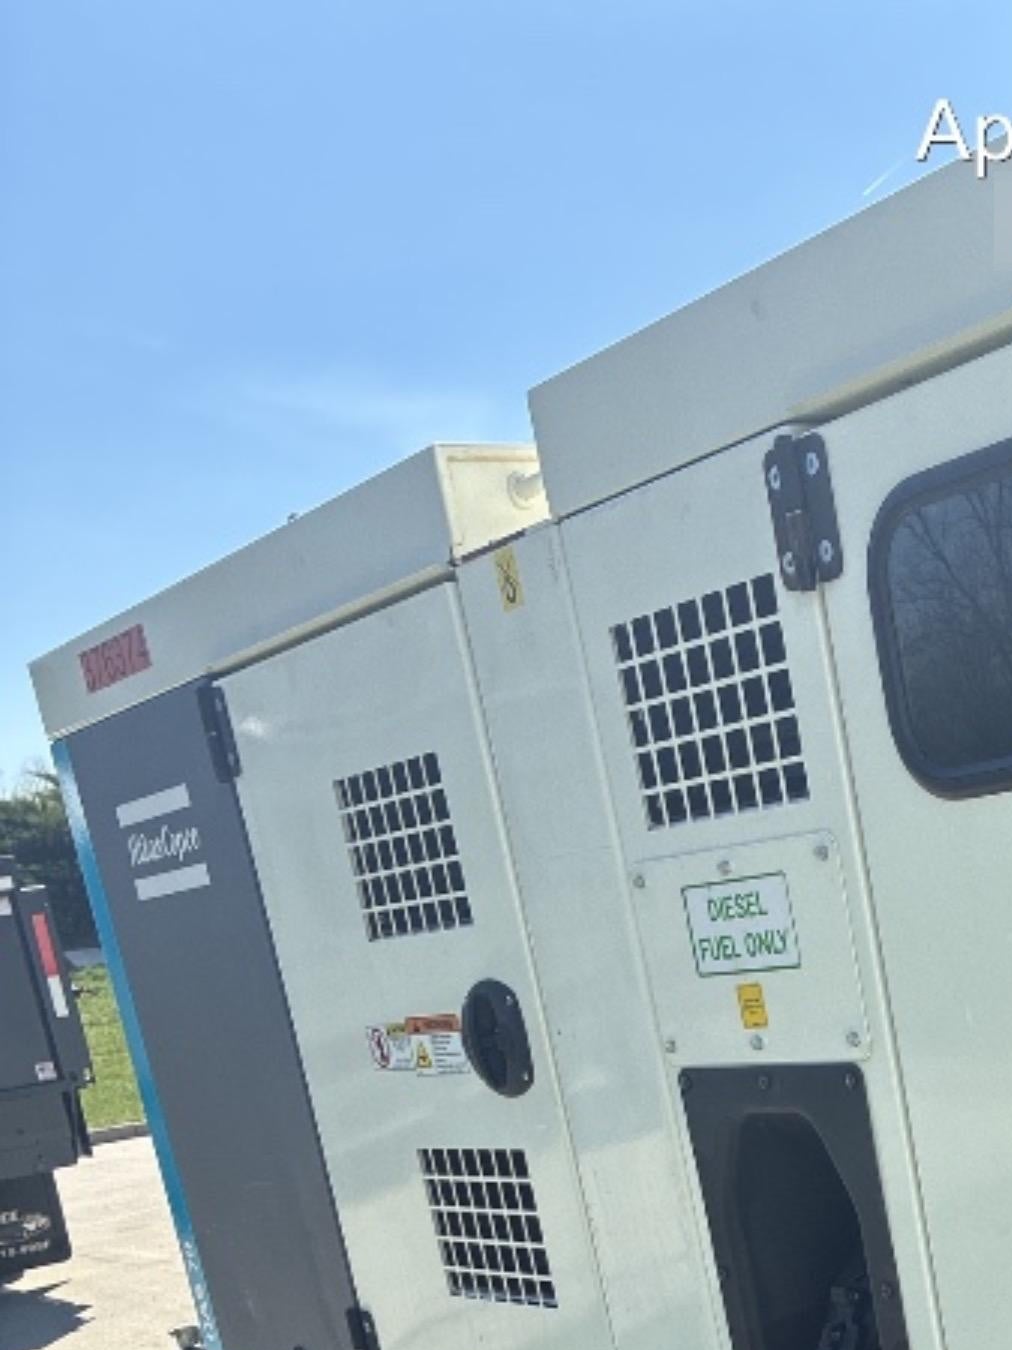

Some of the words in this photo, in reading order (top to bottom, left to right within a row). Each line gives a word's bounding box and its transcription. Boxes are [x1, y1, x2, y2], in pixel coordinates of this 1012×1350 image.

[707, 891, 767, 921] DIESEL
[699, 936, 741, 961] FUEL
[745, 929, 788, 957] ONLY
